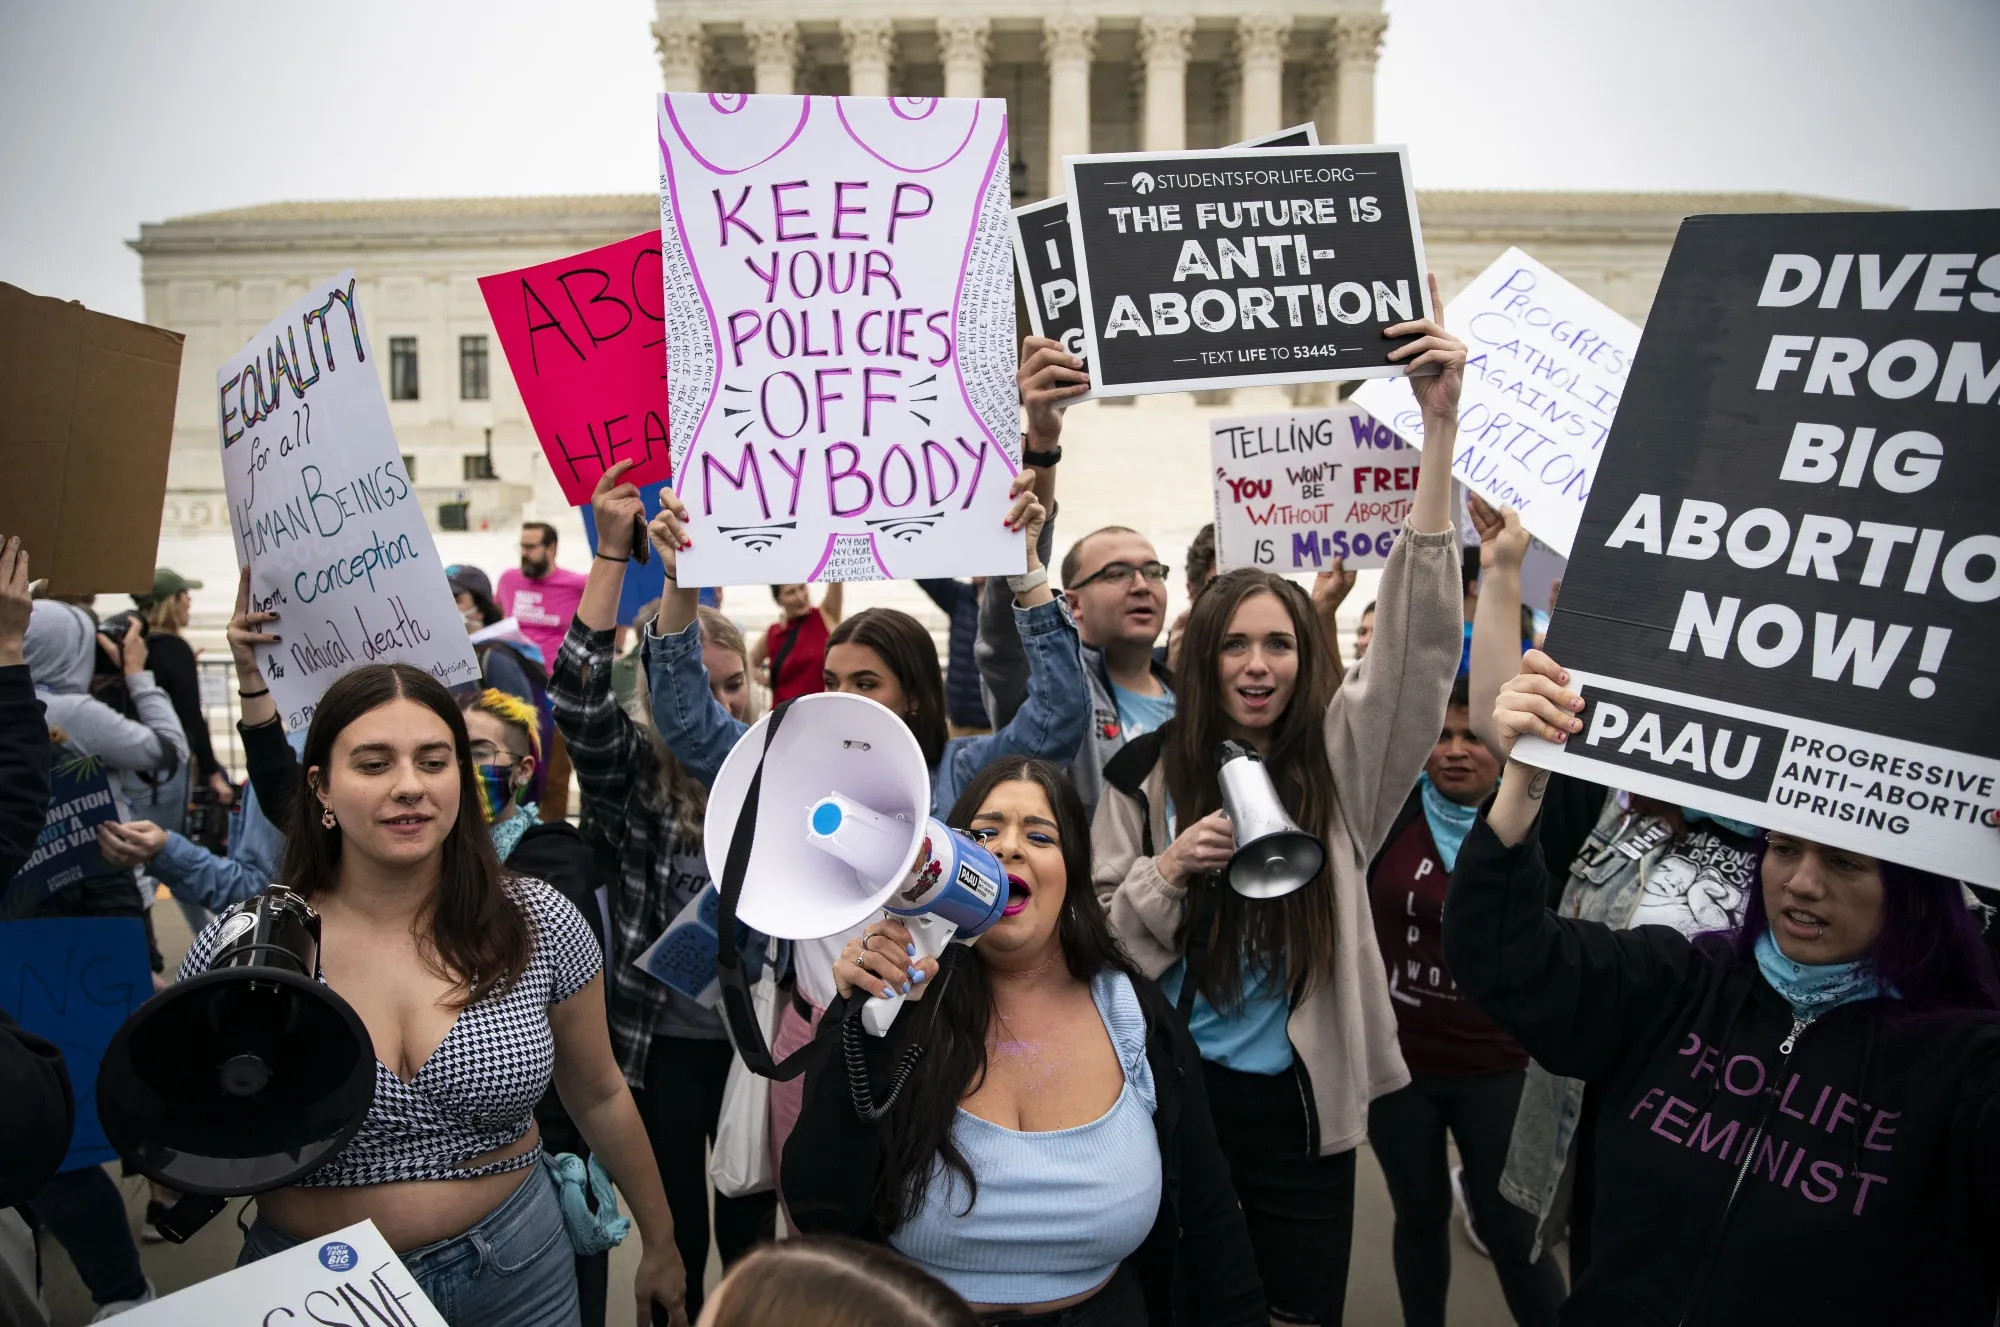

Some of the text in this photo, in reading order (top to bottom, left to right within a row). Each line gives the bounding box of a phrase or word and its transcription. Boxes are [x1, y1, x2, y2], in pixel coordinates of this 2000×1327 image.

[1158, 168, 1355, 189] STUDENTSFORLIFE.ORG
[711, 179, 934, 248] KEEP
[1108, 196, 1382, 234] THE FUTURE IS
[743, 249, 902, 304] YOUR
[1173, 234, 1335, 282] ANTI-
[727, 307, 953, 368] POLICIES
[1104, 280, 1414, 339] ABORTION
[220, 278, 365, 449] EQUALITY
[1200, 344, 1337, 365] TEXT LIFE TO 53445
[760, 366, 902, 440] OFF
[1465, 353, 1609, 450] AGAINST
[247, 403, 311, 510] for all
[701, 435, 989, 520] MY BODY
[1286, 462, 1343, 486] WON'T
[1779, 422, 1945, 494] BIG
[1302, 483, 1325, 500] BE
[1253, 539, 1275, 564] IS
[267, 654, 285, 681] to
[354, 595, 431, 661] death
[1668, 590, 1953, 700] NOW!
[1585, 701, 1761, 781] PAAU
[1790, 735, 1995, 798] PROGRESSIVE
[37, 816, 83, 846] NOT A
[1775, 787, 1910, 835] UPRISING
[961, 868, 978, 887] PAAU
[1629, 1087, 1888, 1216] FEMINIST
[328, 1255, 349, 1264] BIG
